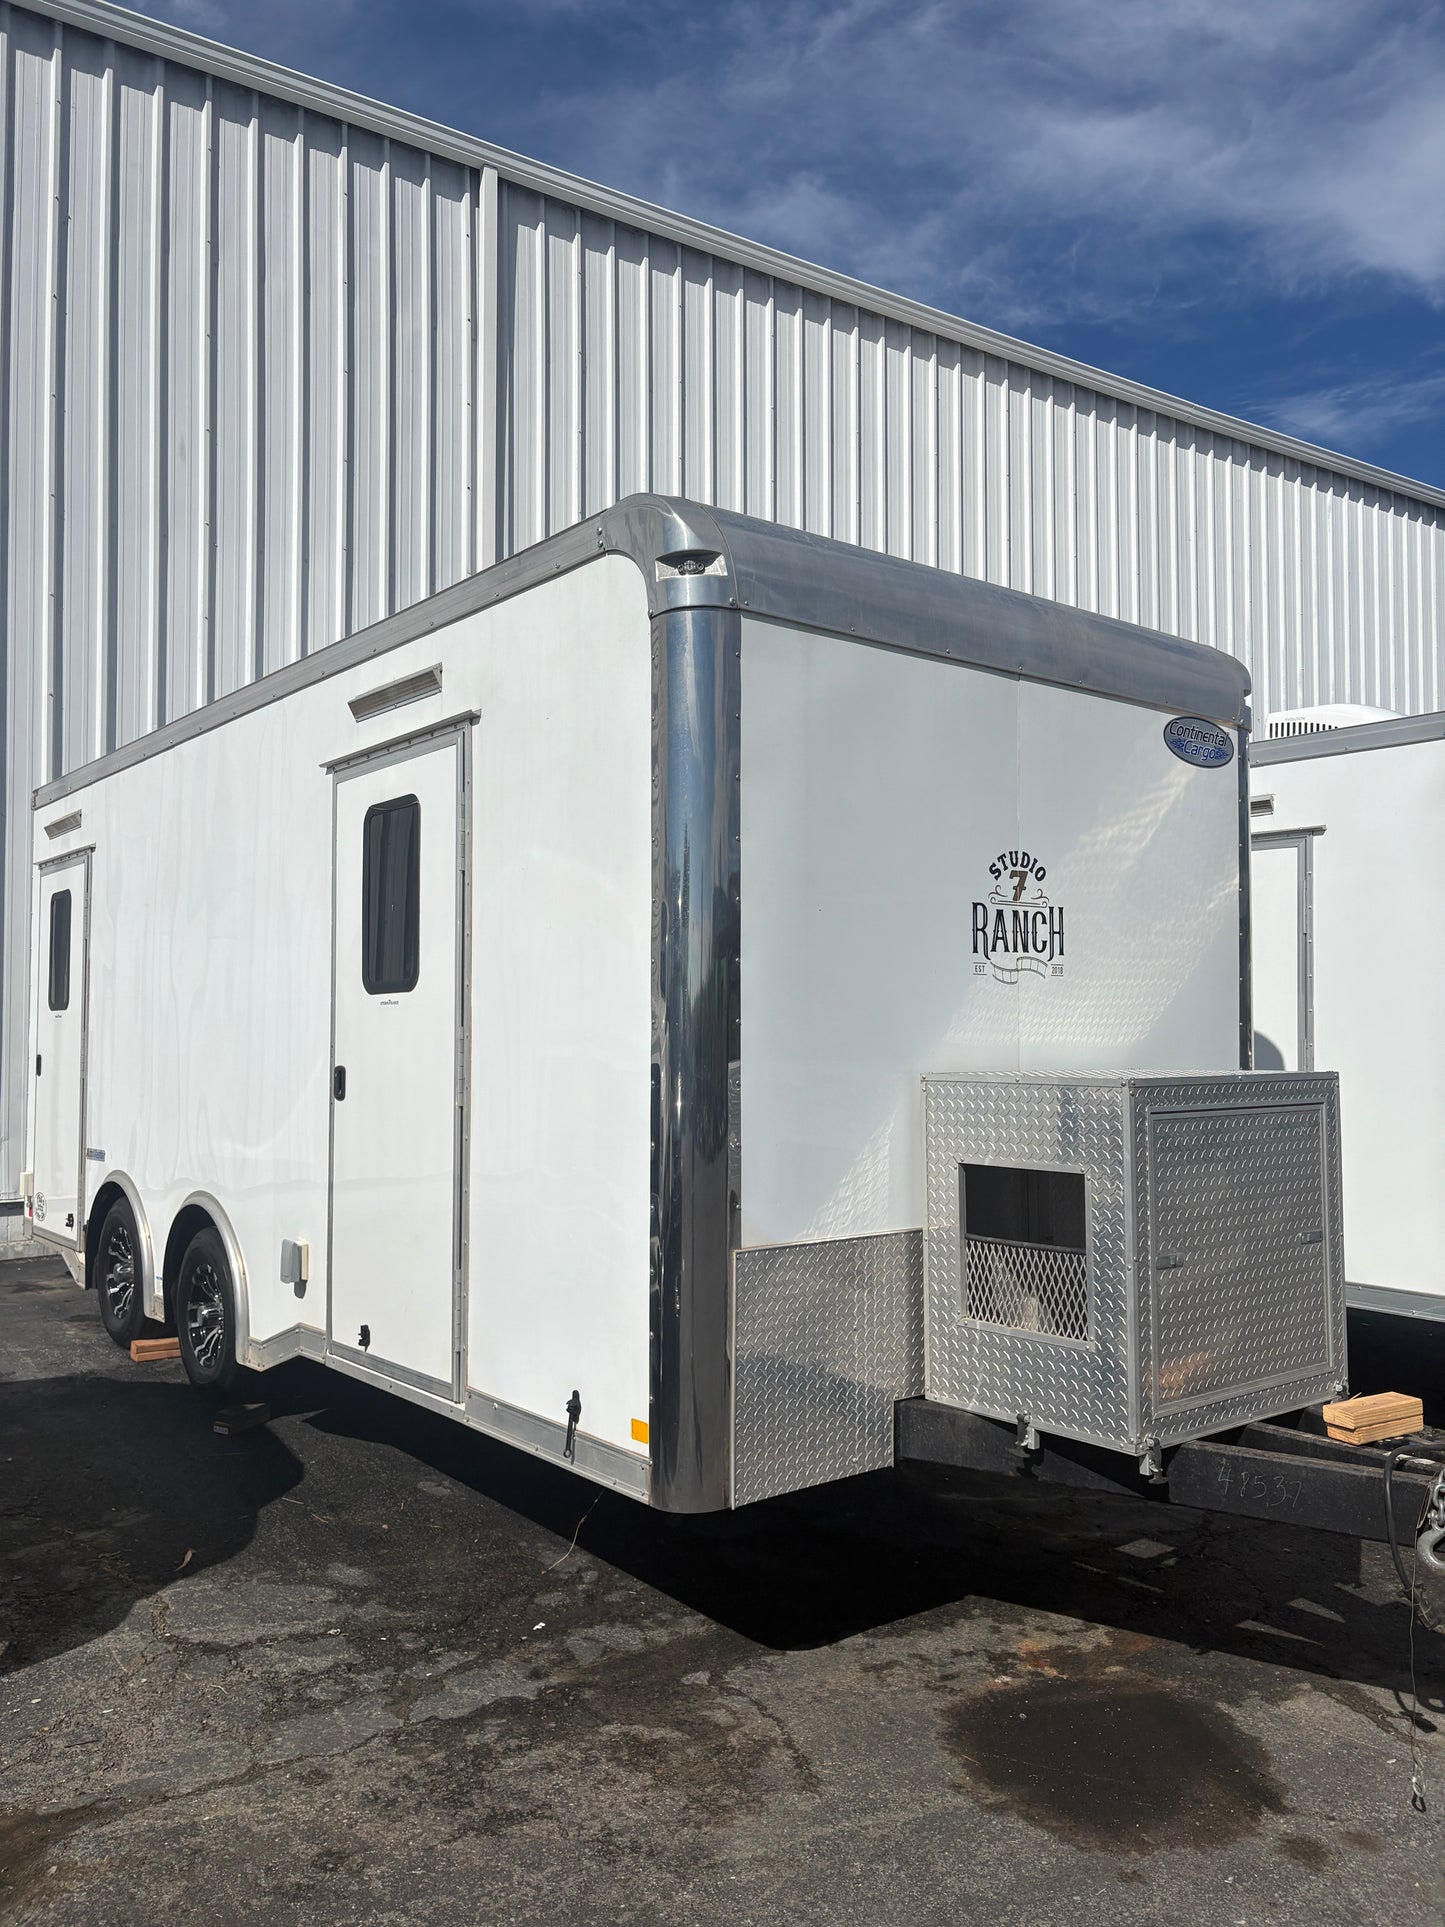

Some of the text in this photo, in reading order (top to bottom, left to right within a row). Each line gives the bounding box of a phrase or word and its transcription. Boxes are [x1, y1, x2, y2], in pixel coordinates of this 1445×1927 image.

[1169, 721, 1229, 747] Continental
[1184, 740, 1216, 761] Cargo
[989, 850, 1047, 882] STUDIO
[1009, 869, 1029, 901] 7
[972, 901, 1065, 962] RANCH
[974, 964, 986, 973] EST
[1217, 1463, 1303, 1508] 48537
